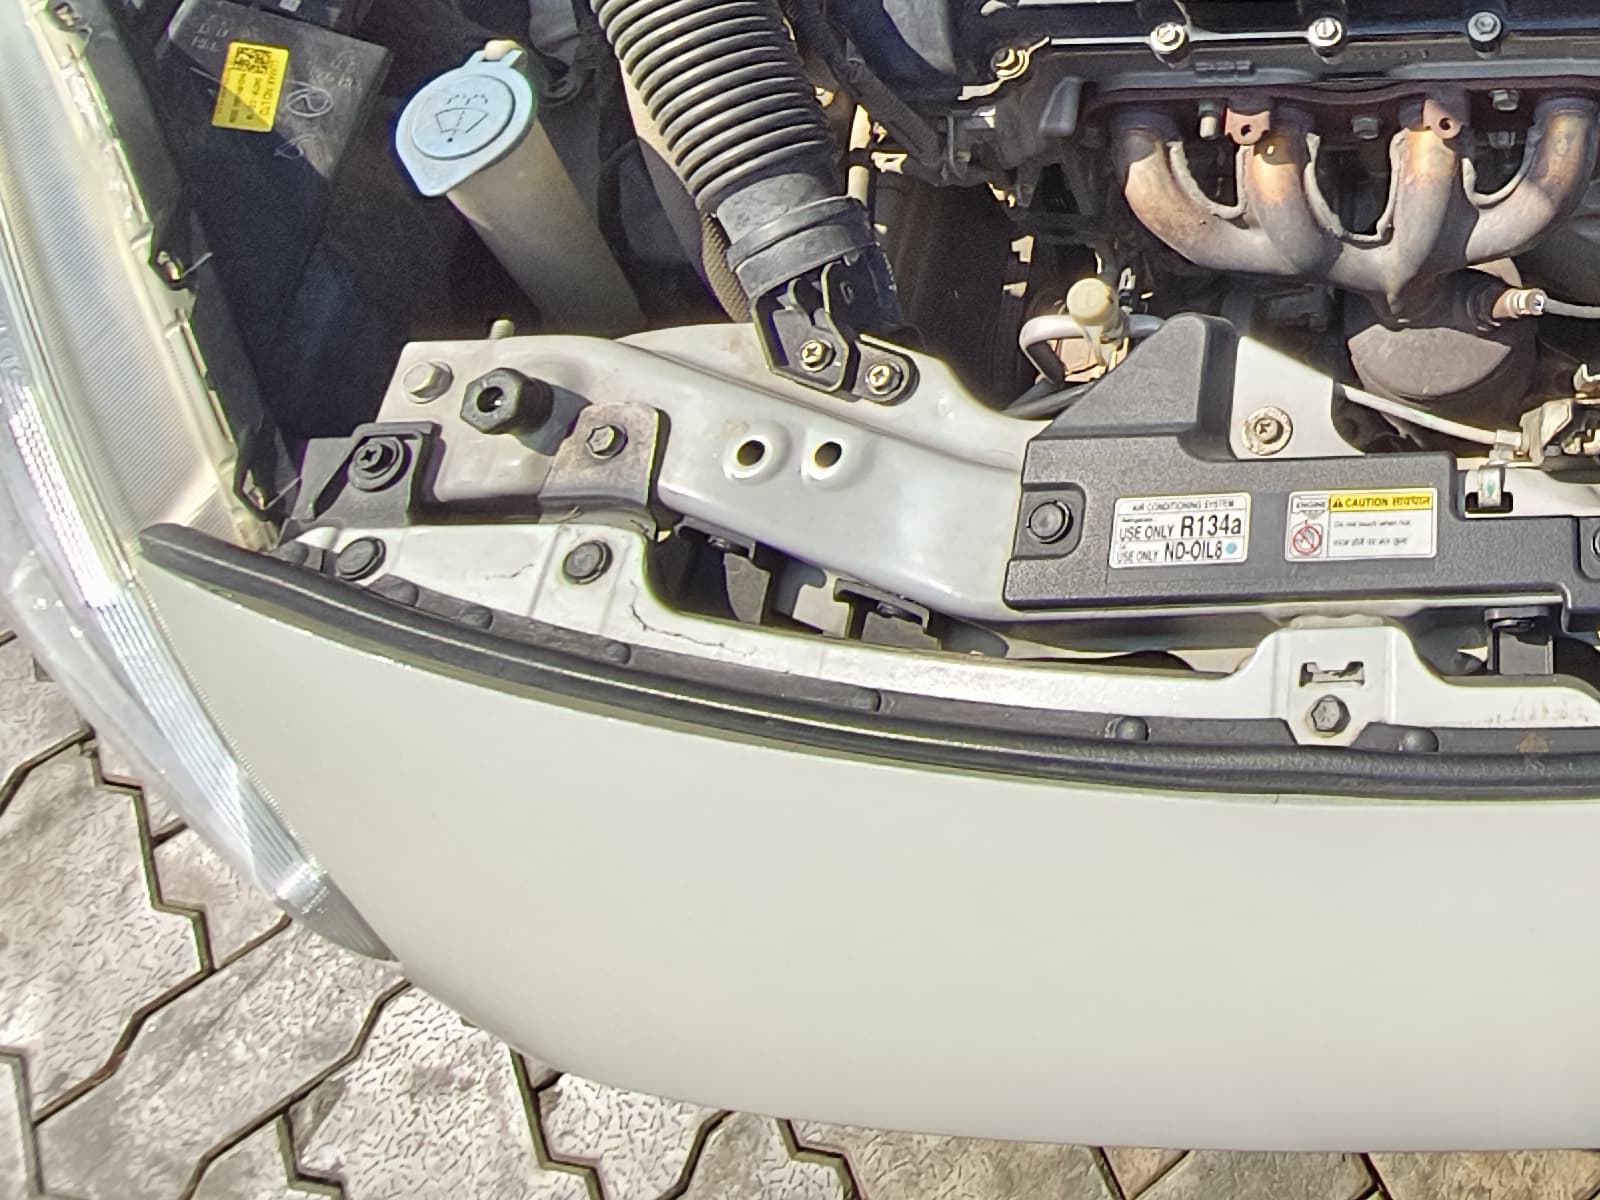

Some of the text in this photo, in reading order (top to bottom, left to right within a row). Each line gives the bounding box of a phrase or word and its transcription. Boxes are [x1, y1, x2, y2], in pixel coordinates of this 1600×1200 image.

[1204, 499, 1235, 509] SYSTEM
[1296, 501, 1326, 509] ENGINE
[1345, 496, 1388, 508] CAUTION
[1120, 513, 1242, 540] USE ONLY R134a
[1117, 540, 1223, 561] USE ONLY ND-OIL8
